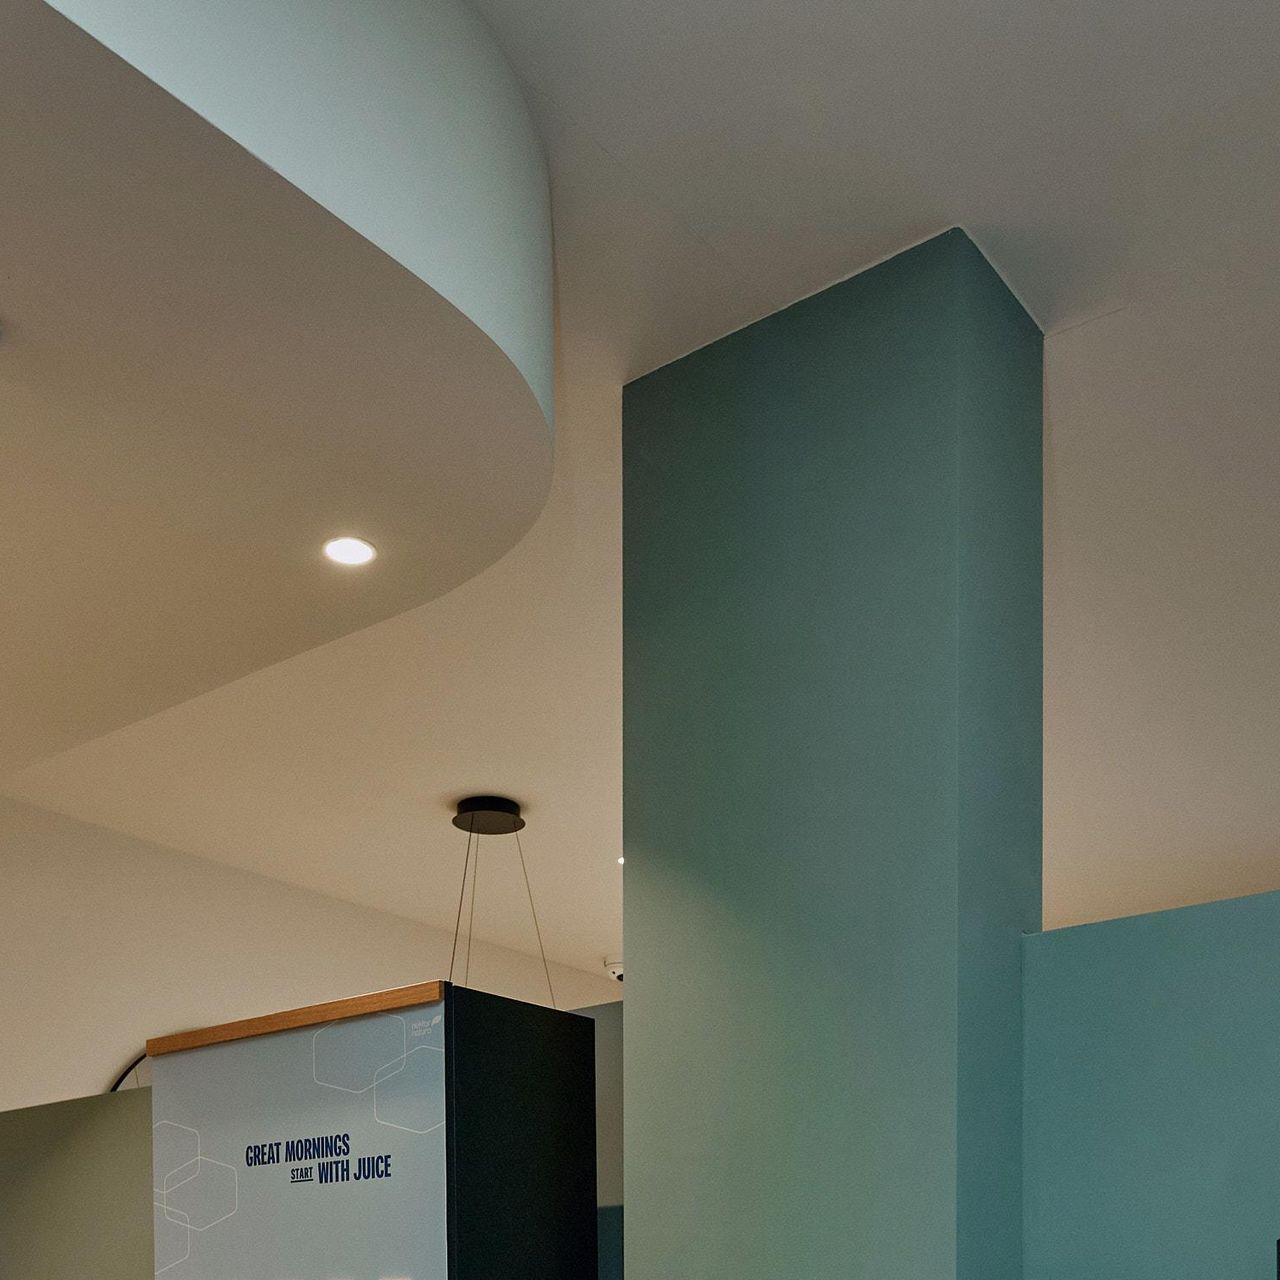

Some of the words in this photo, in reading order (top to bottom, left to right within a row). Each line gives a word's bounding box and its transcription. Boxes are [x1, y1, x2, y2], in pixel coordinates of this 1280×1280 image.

[245, 1142, 282, 1167] GREAT
[285, 1133, 350, 1162] MORNINGS
[290, 1167, 313, 1181] START
[318, 1159, 350, 1184] WITH
[353, 1154, 391, 1181] JUICE
